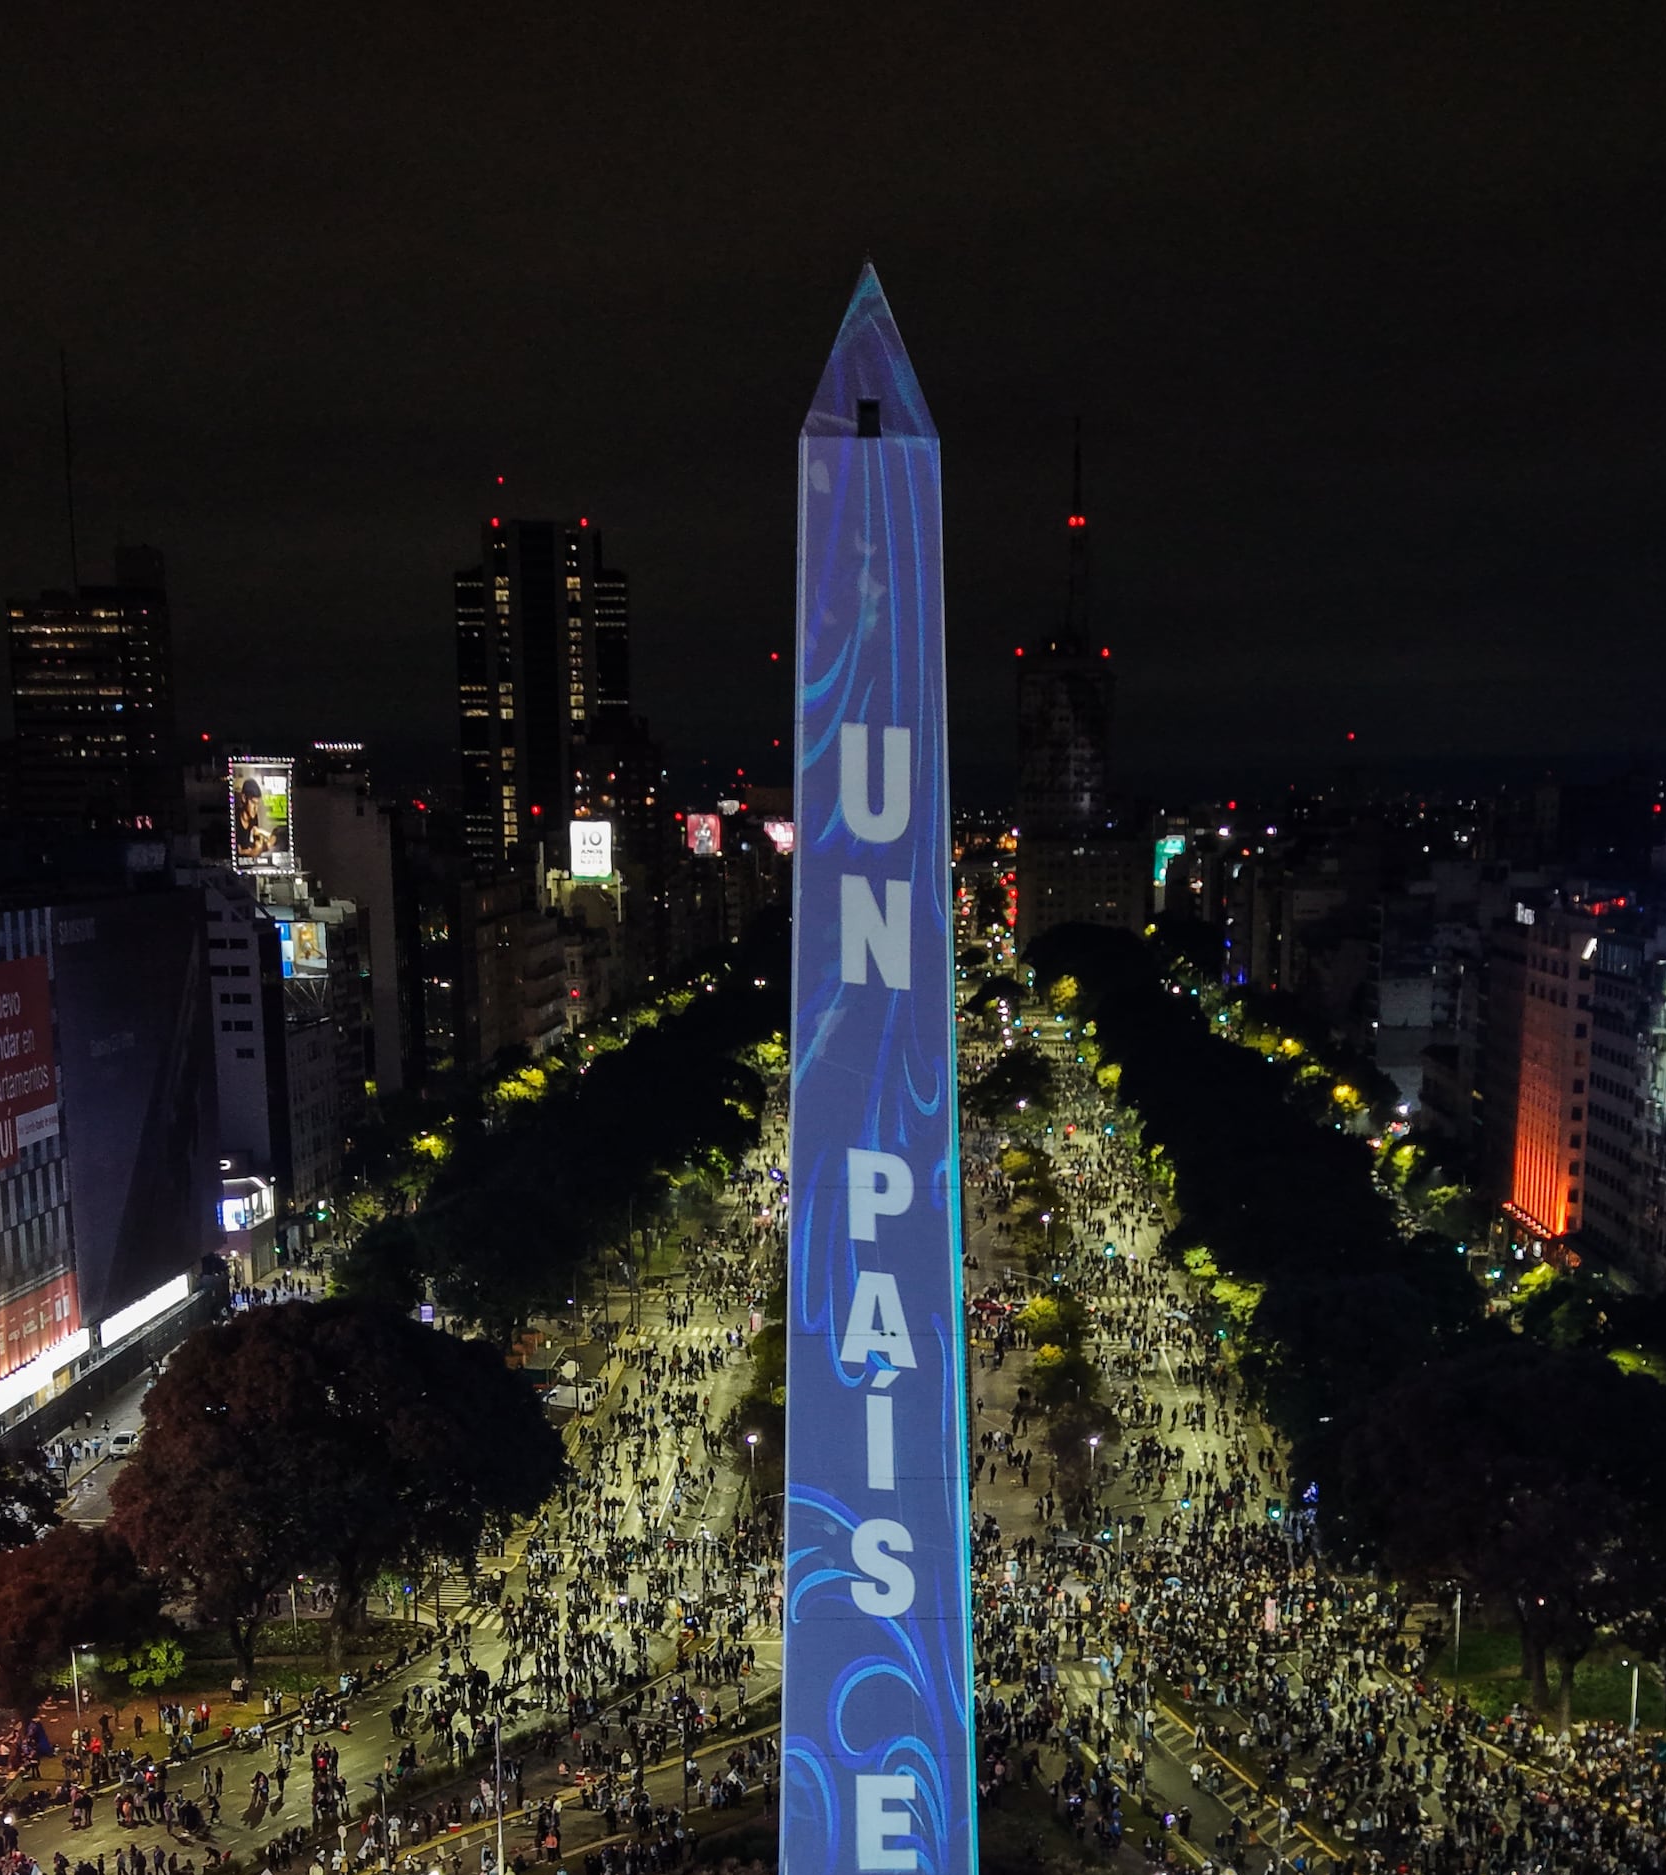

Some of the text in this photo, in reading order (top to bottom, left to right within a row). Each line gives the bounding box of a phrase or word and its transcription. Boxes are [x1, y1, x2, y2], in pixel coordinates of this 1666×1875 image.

[581, 832, 602, 846] 10
[841, 724, 910, 989] UN
[22, 1028, 36, 1054] en
[840, 1148, 917, 1617] PAÍS
